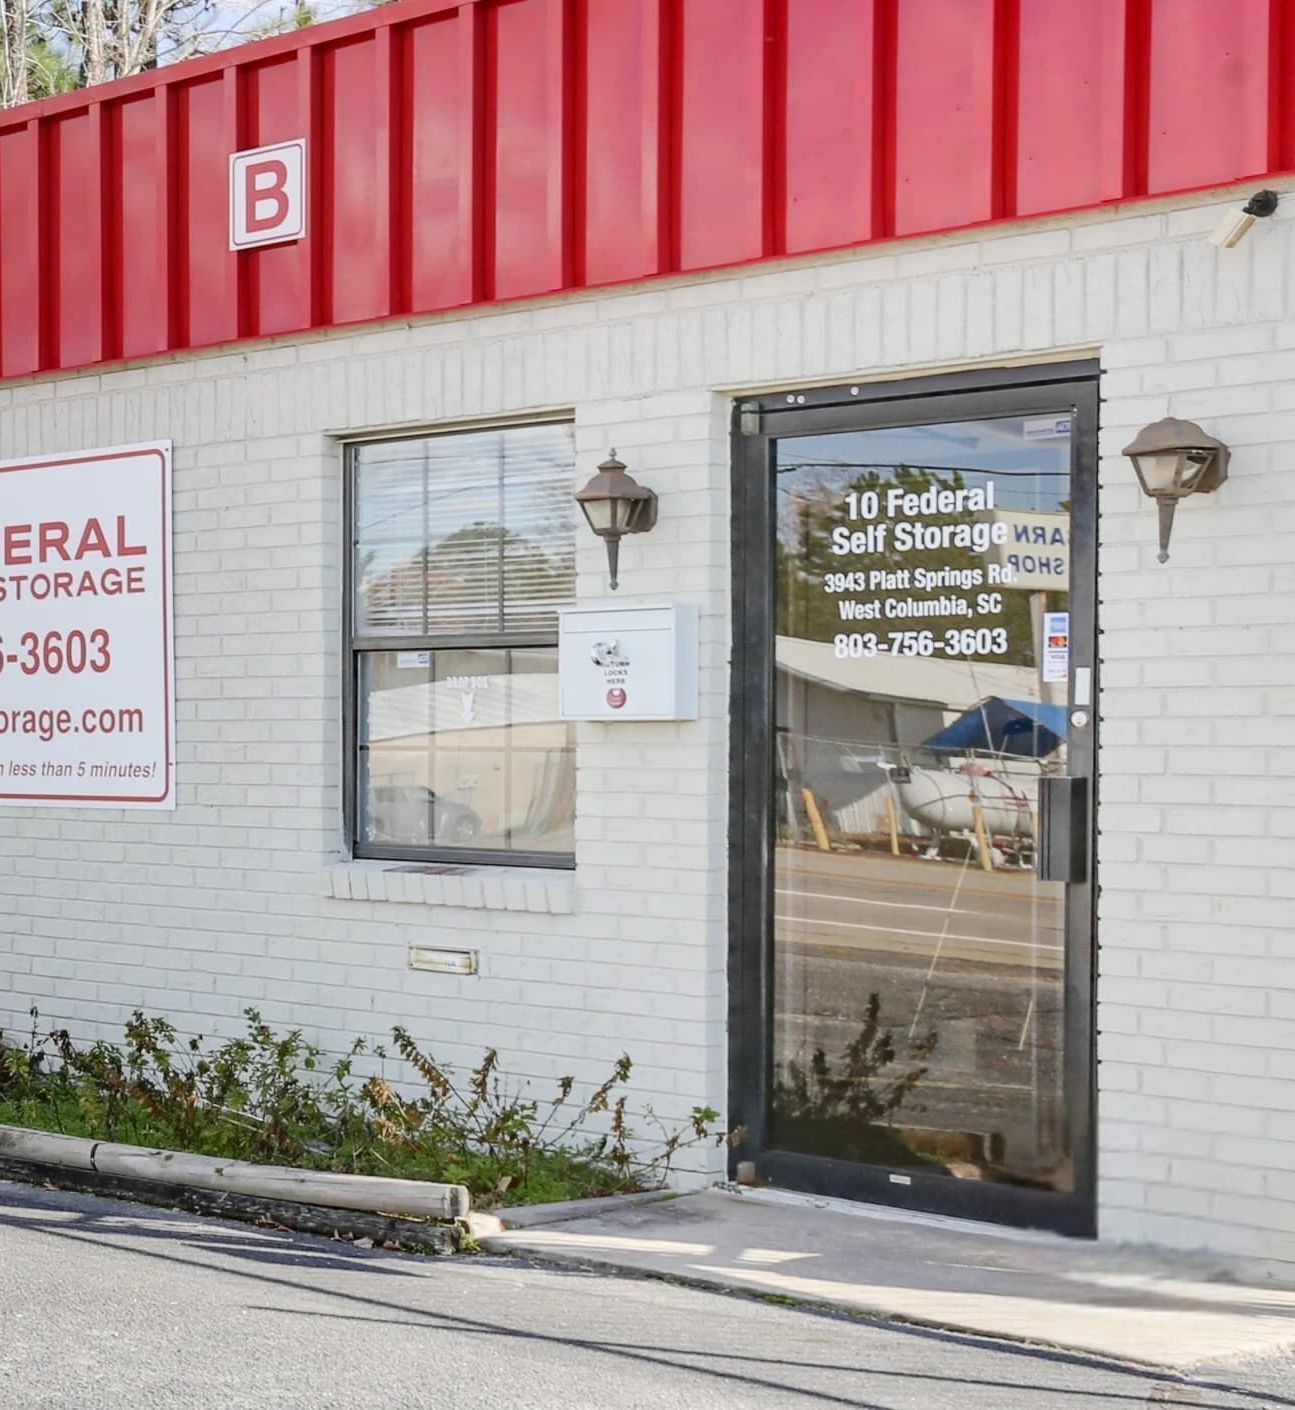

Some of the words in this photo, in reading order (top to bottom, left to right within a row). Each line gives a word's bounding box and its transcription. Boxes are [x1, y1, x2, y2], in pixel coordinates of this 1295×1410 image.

[246, 160, 289, 233] B
[845, 491, 879, 520] 10
[887, 481, 994, 517] Federal
[832, 524, 887, 555] Self
[894, 521, 1008, 552] Storage
[824, 572, 865, 593] 3943
[870, 570, 910, 590] Platt
[914, 566, 983, 591] Springs
[987, 563, 1018, 585] Rd.
[838, 600, 881, 620] West
[884, 595, 973, 618] Columbia,
[977, 593, 1002, 614] SC
[834, 628, 1008, 658] 803-756-3603
[9, 761, 36, 776] less
[41, 761, 72, 776] than
[77, 761, 86, 777] 5
[90, 762, 157, 778] minutes!
